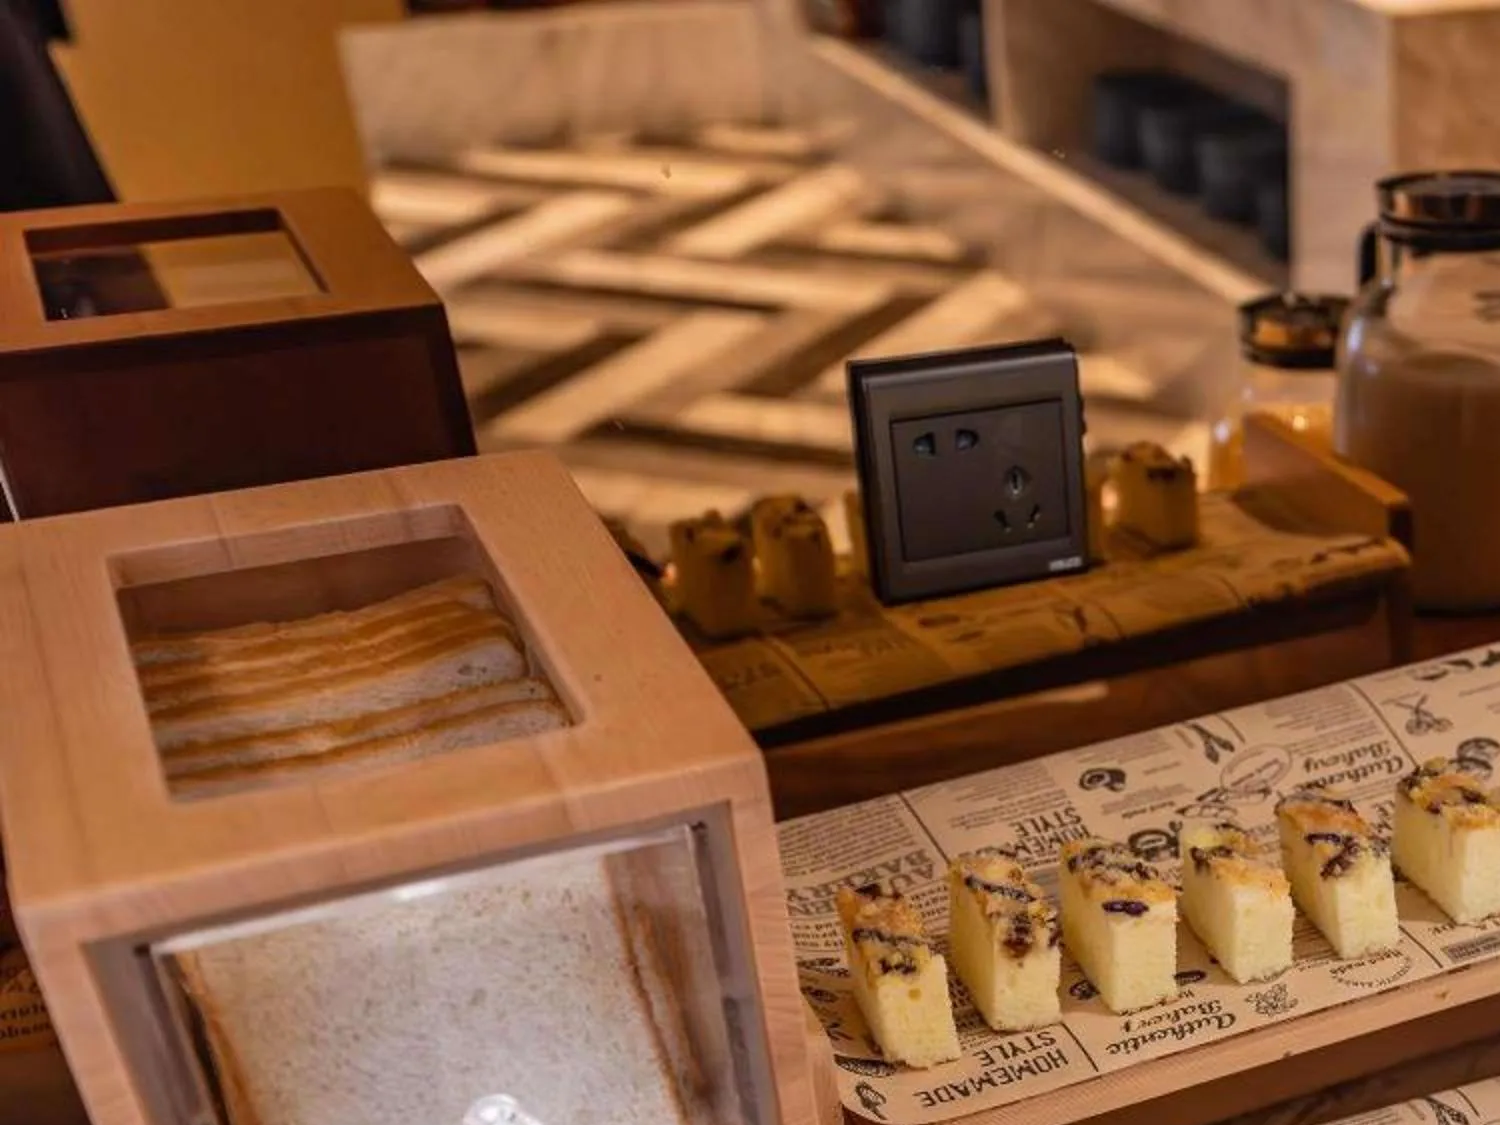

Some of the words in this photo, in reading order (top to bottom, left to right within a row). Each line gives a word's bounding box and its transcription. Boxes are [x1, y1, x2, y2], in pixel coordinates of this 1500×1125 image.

[1008, 805, 1082, 839] STYLE
[1103, 1009, 1237, 1059] Authentic
[1119, 998, 1222, 1035] Bakery
[971, 1028, 1056, 1068] STYLE
[911, 1047, 1070, 1109] HOMEMADE
